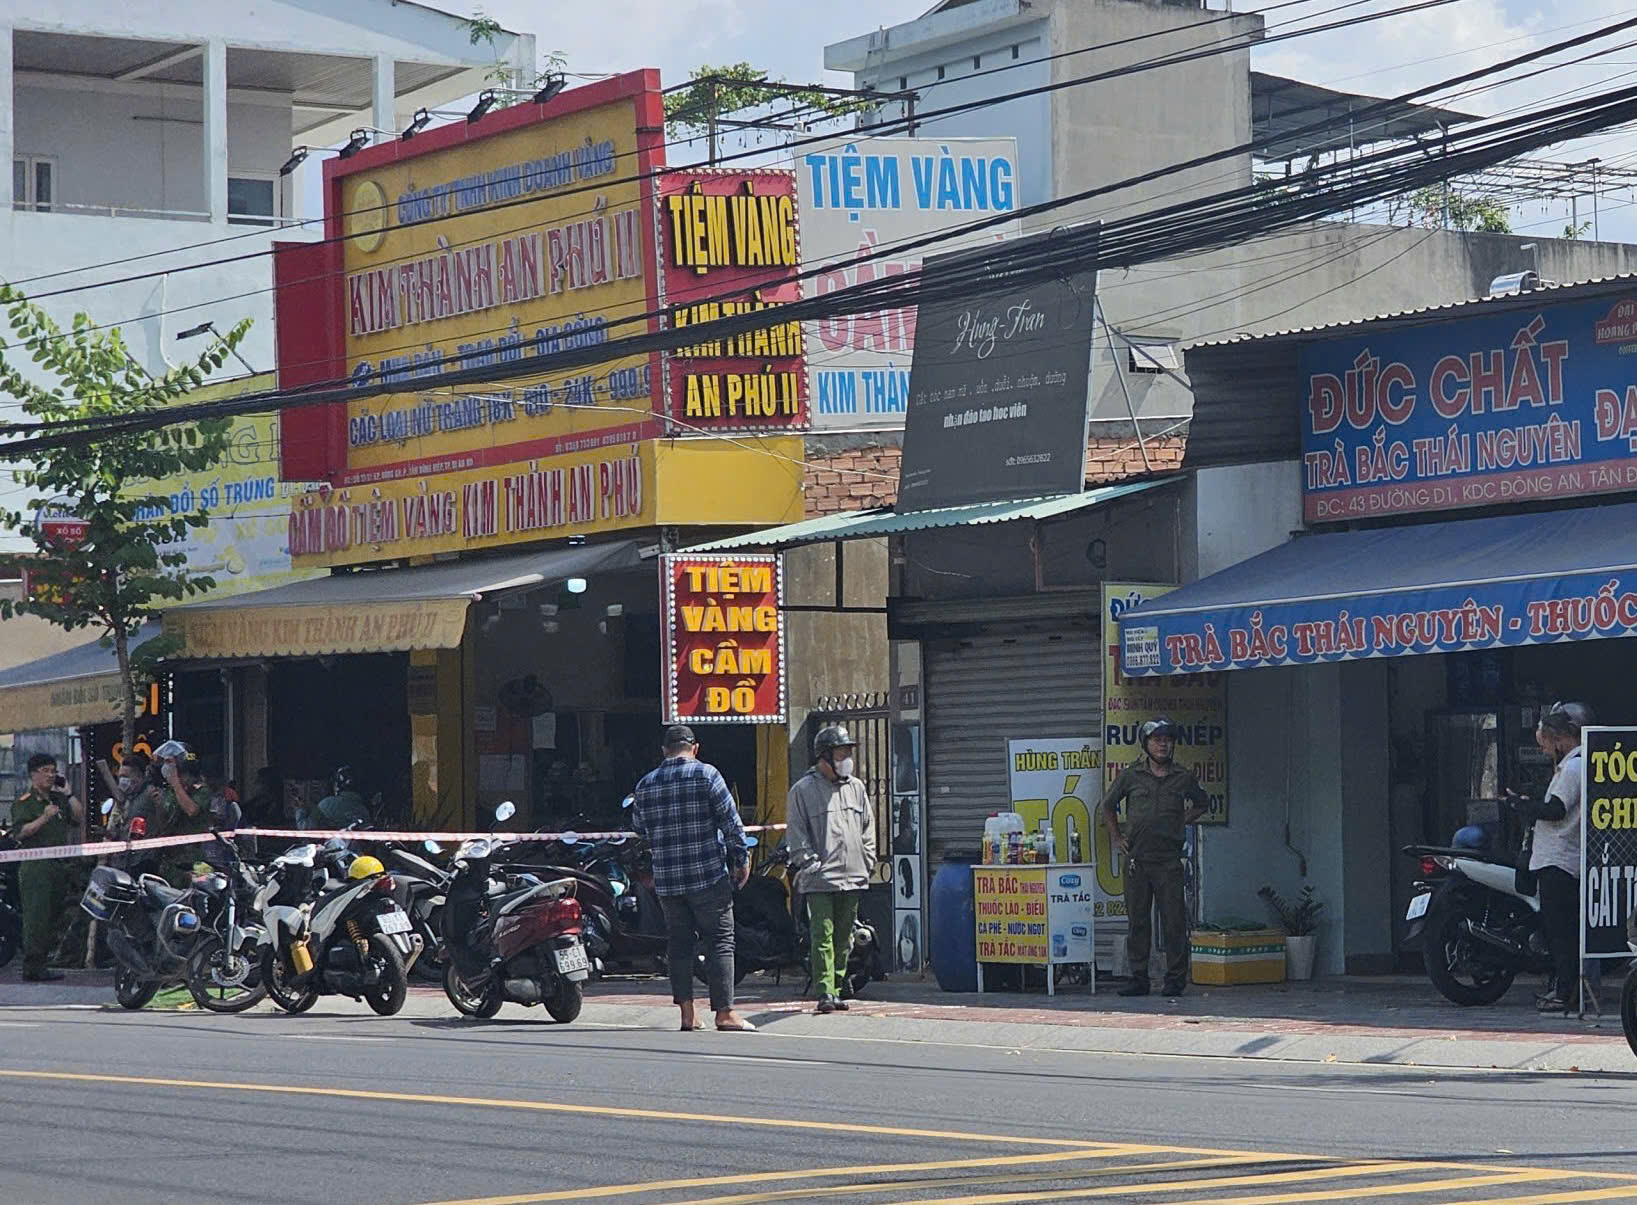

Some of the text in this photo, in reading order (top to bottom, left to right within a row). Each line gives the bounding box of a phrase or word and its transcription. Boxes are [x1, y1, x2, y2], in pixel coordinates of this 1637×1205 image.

[806, 143, 1015, 223] TIỆM VÀNG
[666, 180, 796, 274] TIỆM VÀNG
[350, 262, 399, 337] KIM
[400, 234, 498, 325] THÀNH
[500, 232, 547, 305] AN
[547, 194, 612, 295] PHÚ
[686, 363, 798, 417] AN PHÚ II
[817, 361, 912, 415] KIM THÀN
[1309, 313, 1570, 435] ĐỨC CHẤT
[350, 408, 376, 447] CÁC
[1305, 412, 1582, 489] TRÀ BẮC THÁI NGUYÊN
[224, 476, 276, 506] TRÚNG
[352, 487, 399, 552] TIỆM
[403, 479, 457, 540] VÀNG
[462, 480, 498, 538] KIM
[504, 460, 566, 534] THÀNH
[568, 464, 595, 522] AN
[599, 442, 641, 520] PHÚ
[1317, 498, 1345, 517] ĐC:
[1348, 495, 1366, 512] 43
[1369, 488, 1430, 510] ĐƯỜNG
[1462, 479, 1497, 500] KDC
[1590, 465, 1622, 487] TÂN
[684, 559, 772, 600] TIỆM
[681, 597, 778, 633] VÀNG
[1166, 622, 1225, 667] TRÀ
[1229, 610, 1288, 662] BẮC
[1293, 609, 1368, 656] THÁI
[1371, 596, 1503, 650] NGUYÊN
[1526, 578, 1637, 635] THUỐC
[689, 637, 772, 675] CẦM
[705, 677, 757, 714] ĐỒ
[1015, 748, 1059, 772] HÙNG
[977, 873, 996, 894] TRÀ
[998, 869, 1018, 894] BẮC
[1051, 893, 1071, 904] TRÀ
[1061, 877, 1080, 887] Cozy
[1588, 842, 1621, 929] CẮT
[978, 897, 1003, 915] THUỐC
[979, 938, 996, 957] TRÀ
